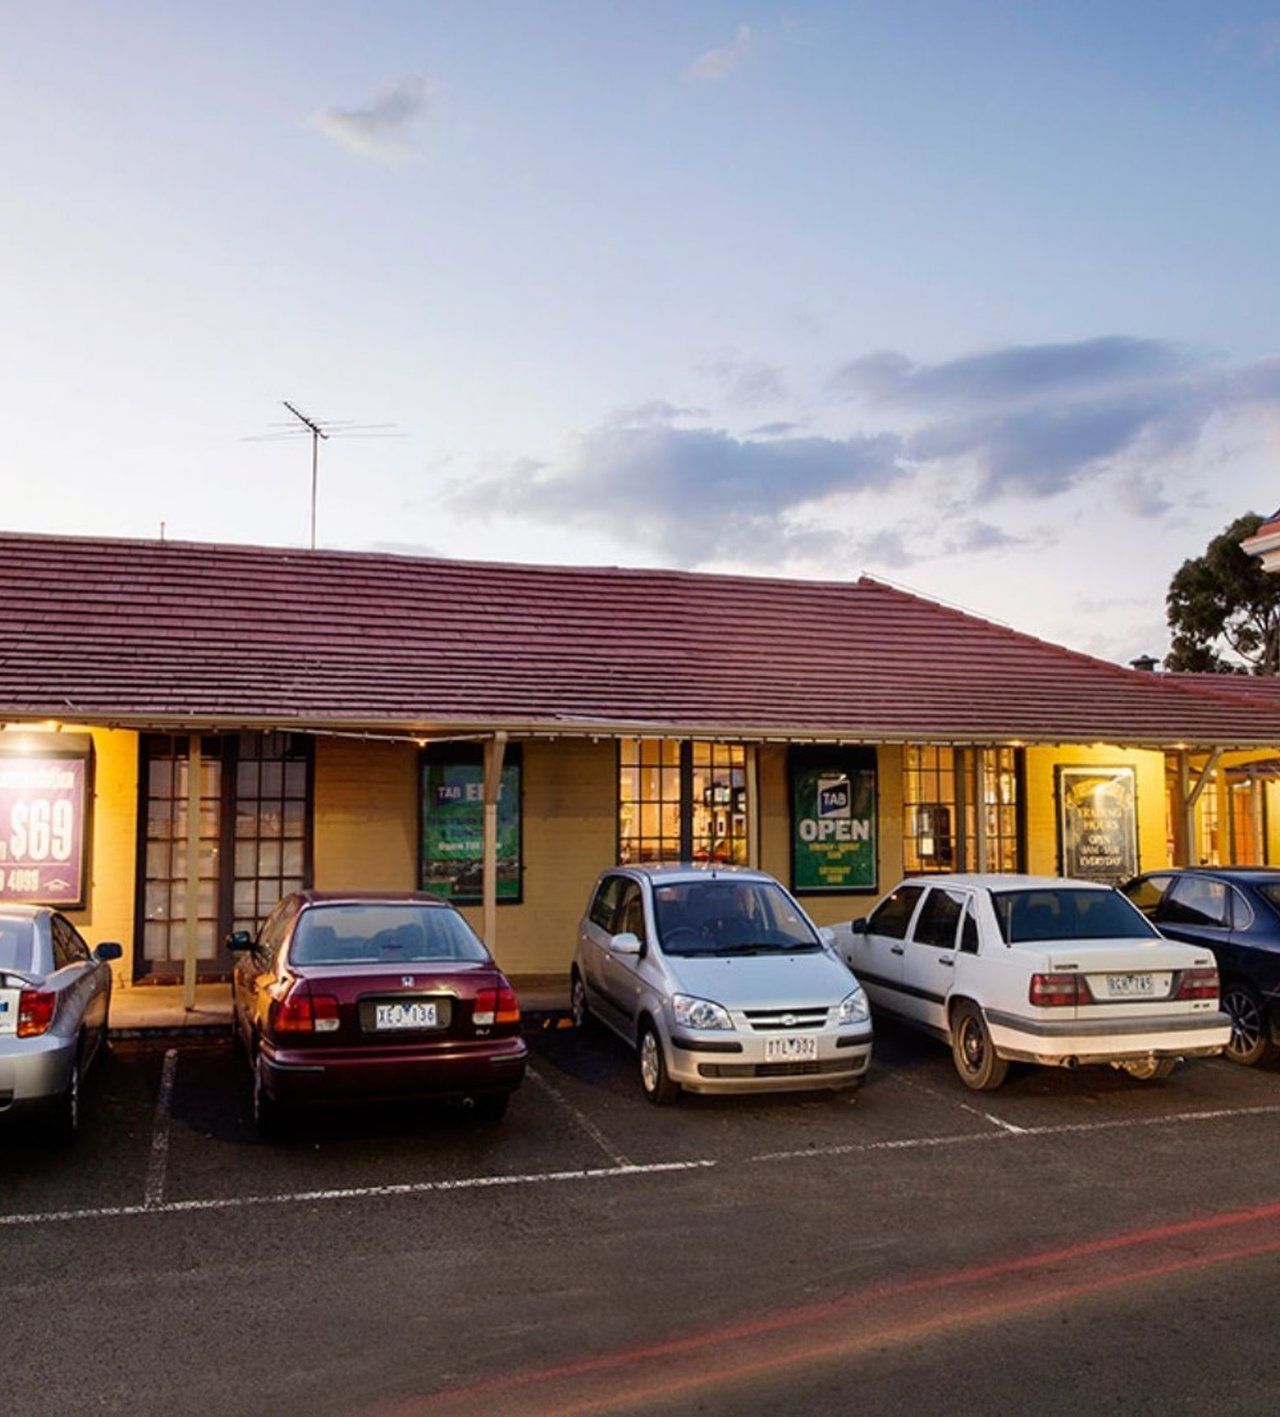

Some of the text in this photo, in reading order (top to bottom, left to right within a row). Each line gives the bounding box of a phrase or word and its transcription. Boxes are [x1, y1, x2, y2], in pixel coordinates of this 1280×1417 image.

[437, 786, 461, 799] TAB
[822, 791, 847, 806] TAB
[10, 799, 73, 861] $69
[799, 818, 870, 841] OPEN
